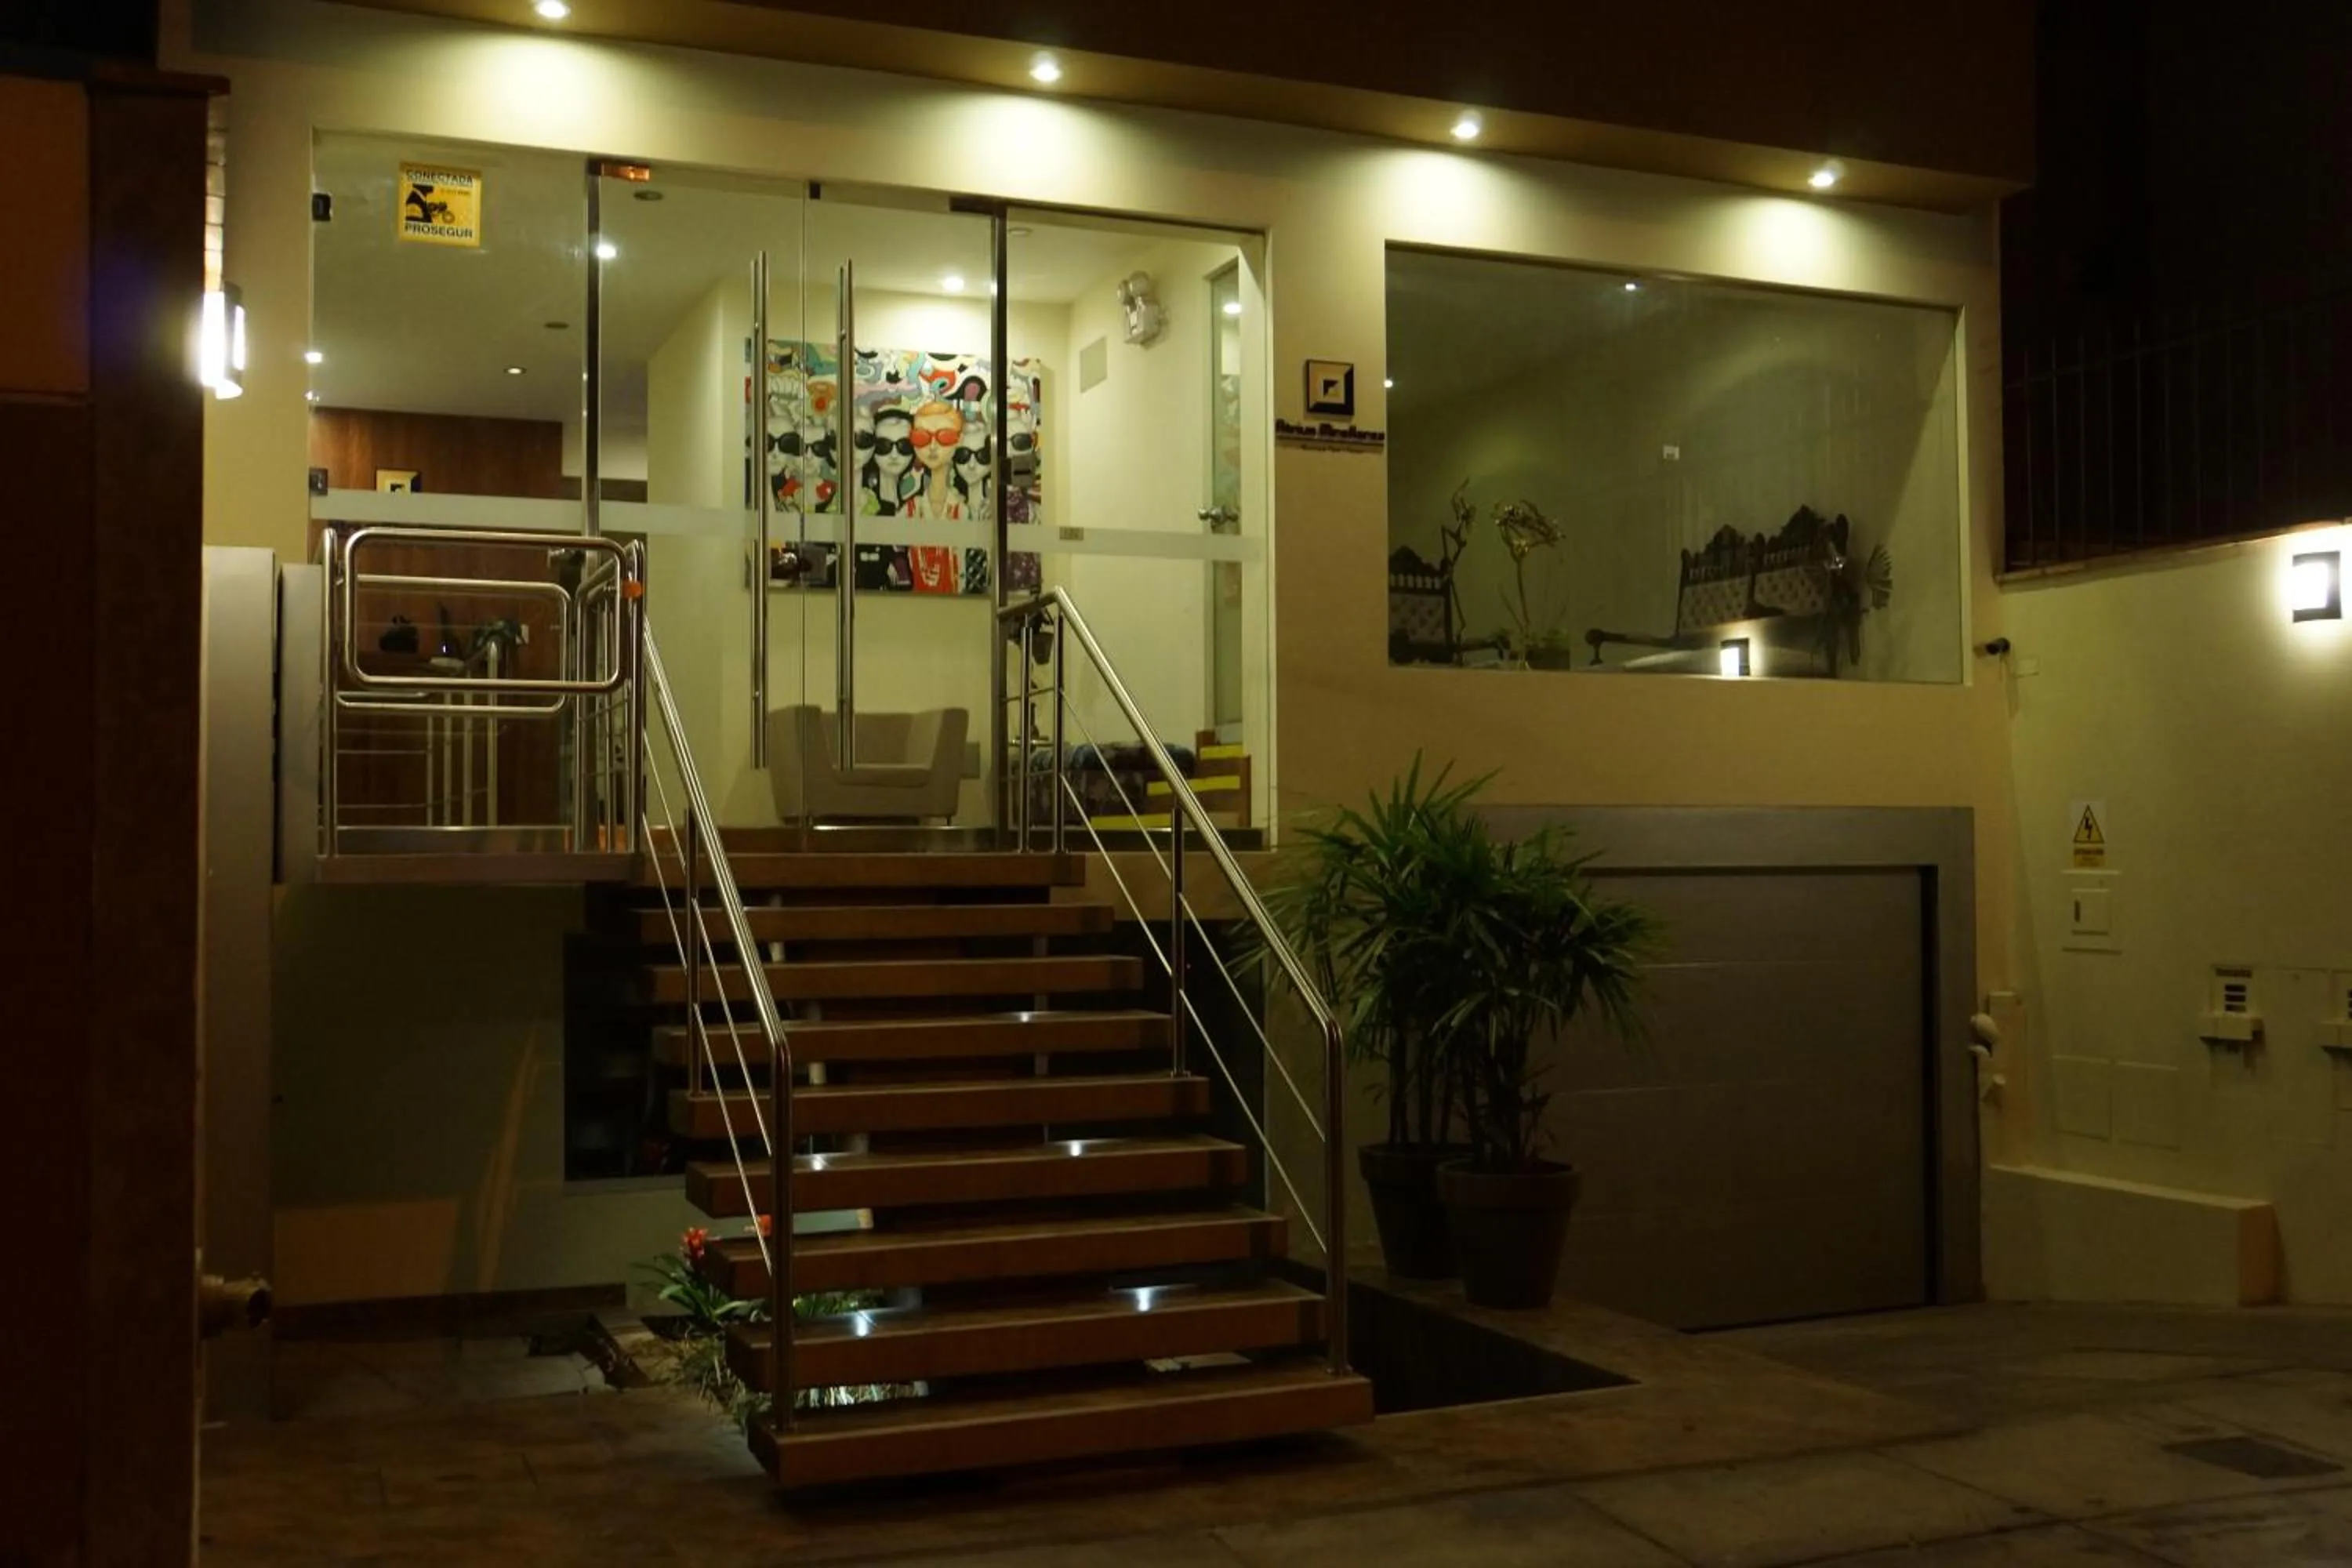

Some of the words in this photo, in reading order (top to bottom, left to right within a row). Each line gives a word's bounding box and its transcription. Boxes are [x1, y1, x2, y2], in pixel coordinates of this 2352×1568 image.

[405, 169, 473, 183] CONECTADA
[405, 223, 473, 238] PROSEGUR
[1319, 423, 1385, 441] Miraflores
